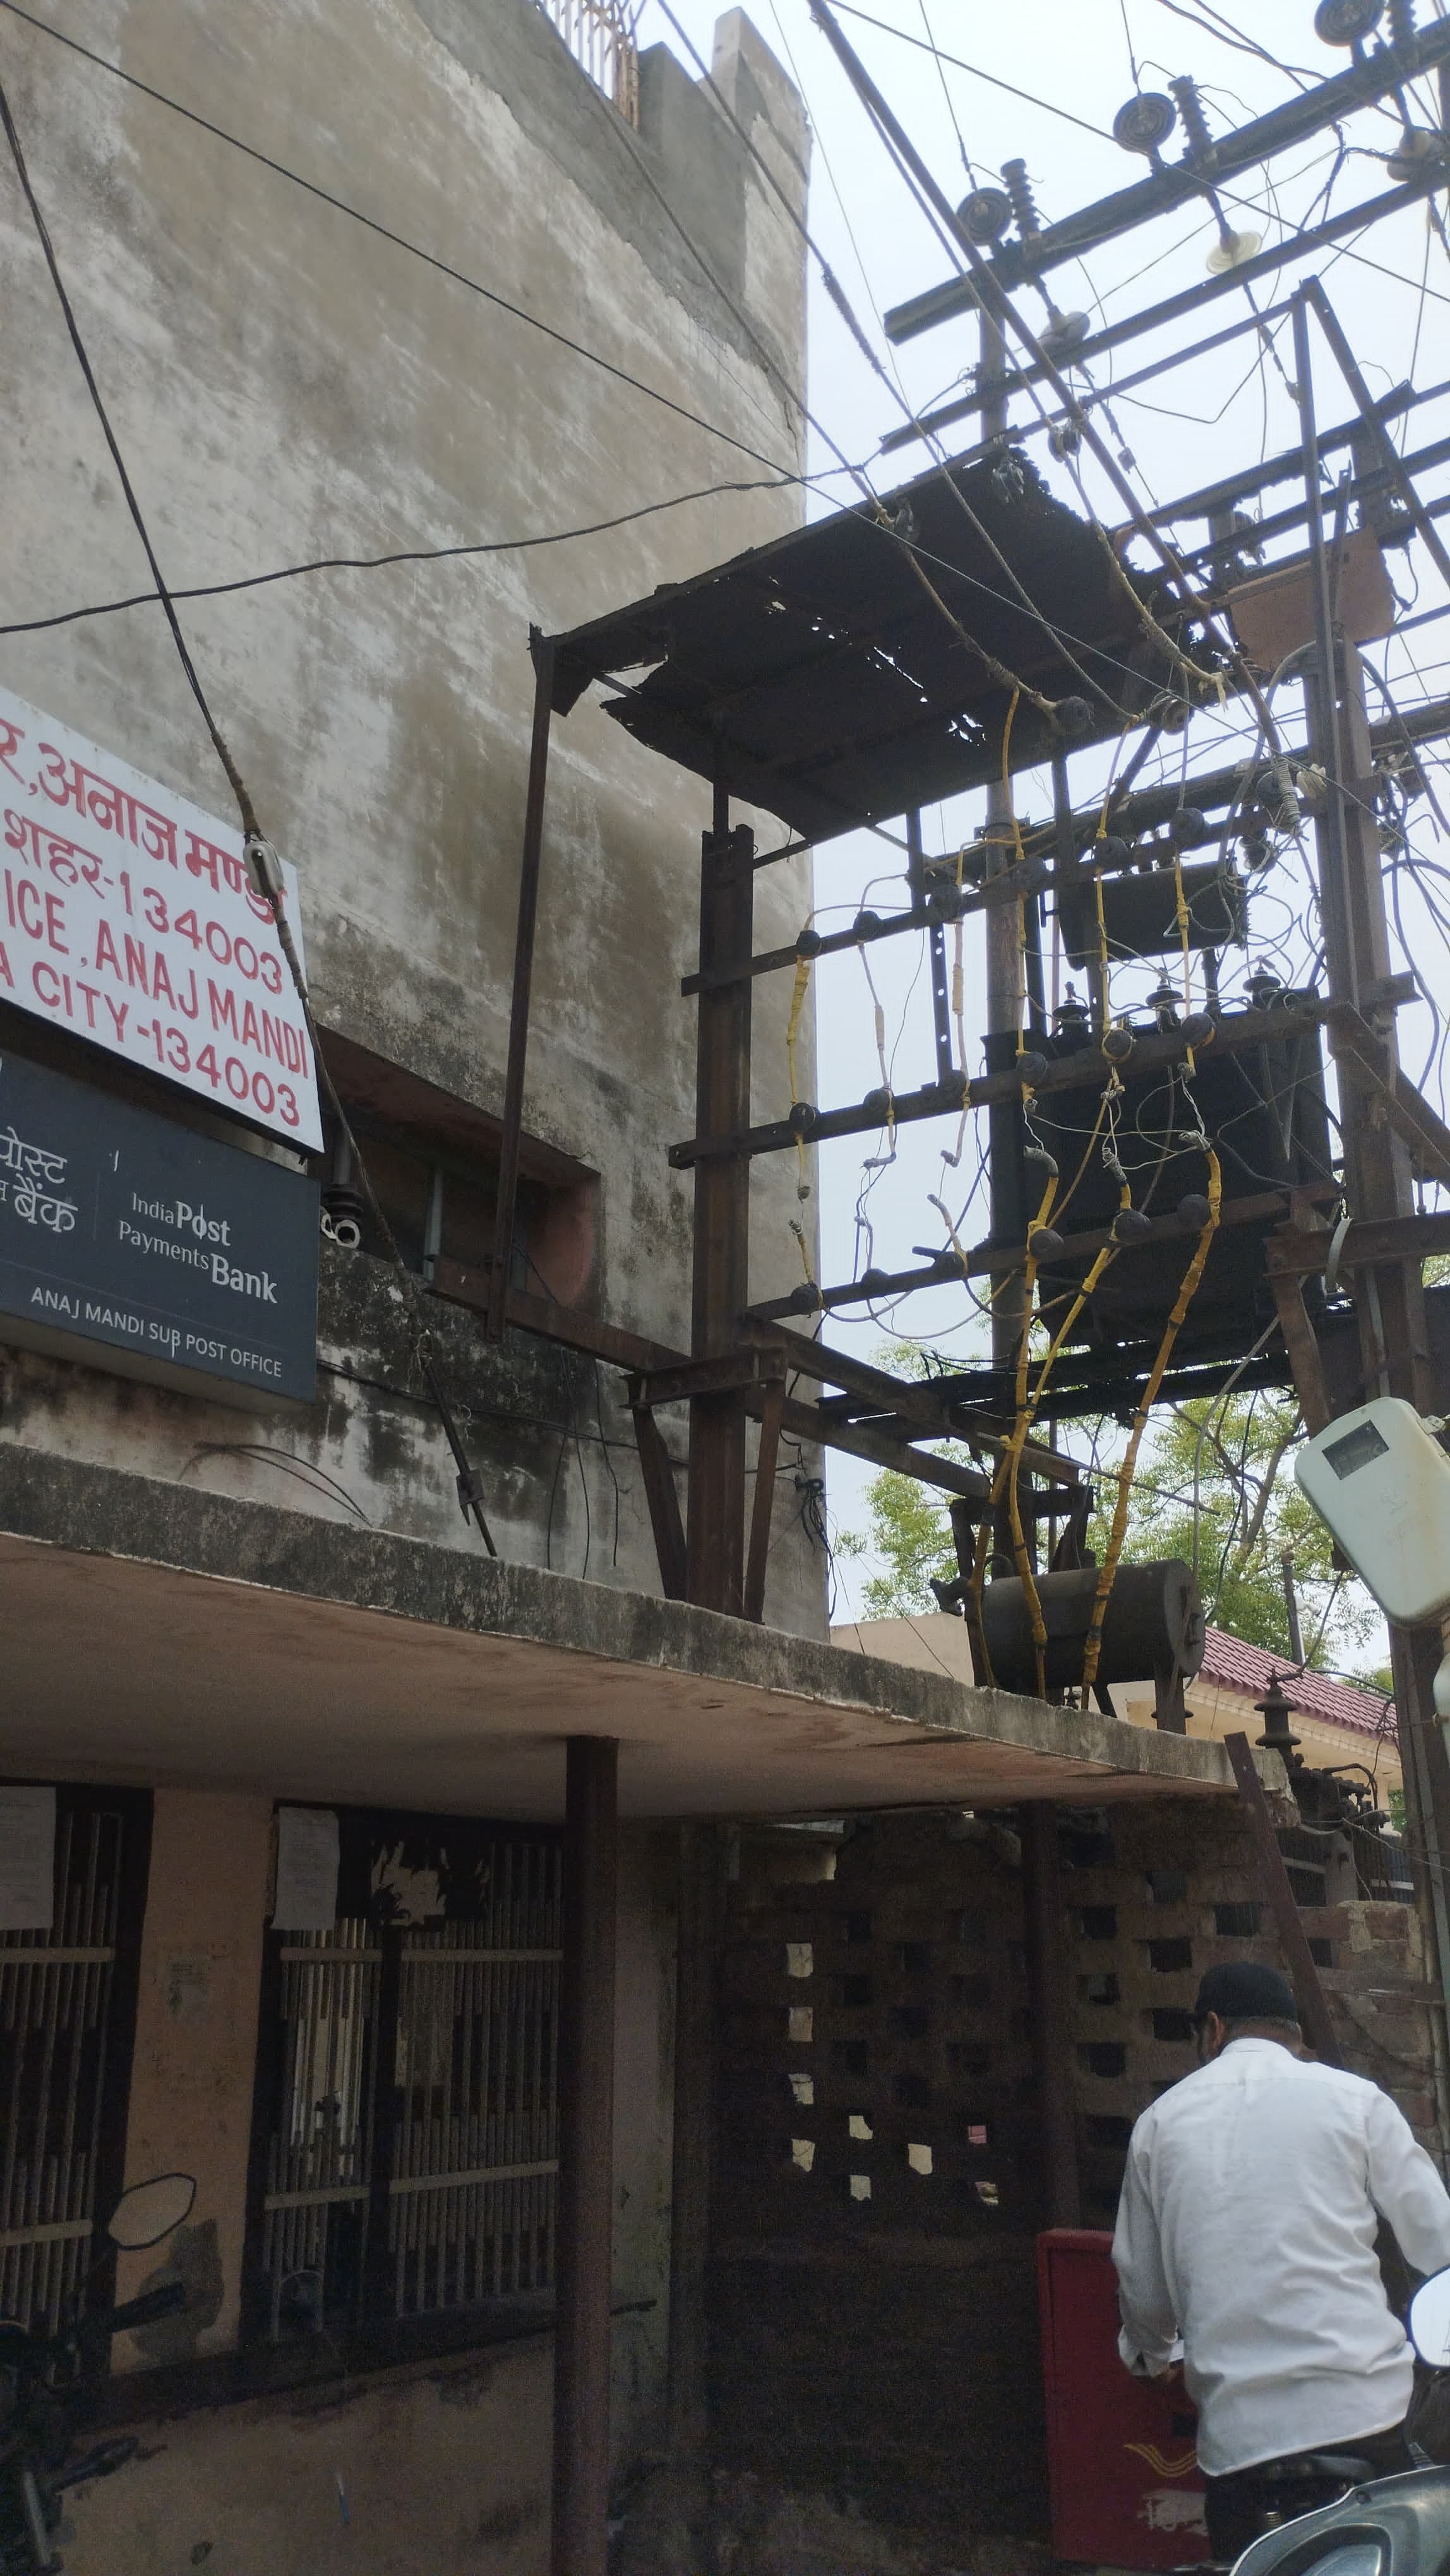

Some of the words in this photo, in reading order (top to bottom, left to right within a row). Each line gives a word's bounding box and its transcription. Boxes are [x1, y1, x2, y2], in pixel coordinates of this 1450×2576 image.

[207, 978, 308, 1079] MANDI
[13, 1173, 78, 1233] बैंक
[31, 1287, 80, 1320] ANAJ
[85, 1303, 145, 1337] MANDI
[149, 1323, 181, 1347] SUB
[186, 1333, 227, 1361] POST
[231, 1348, 282, 1378] OFFICE
